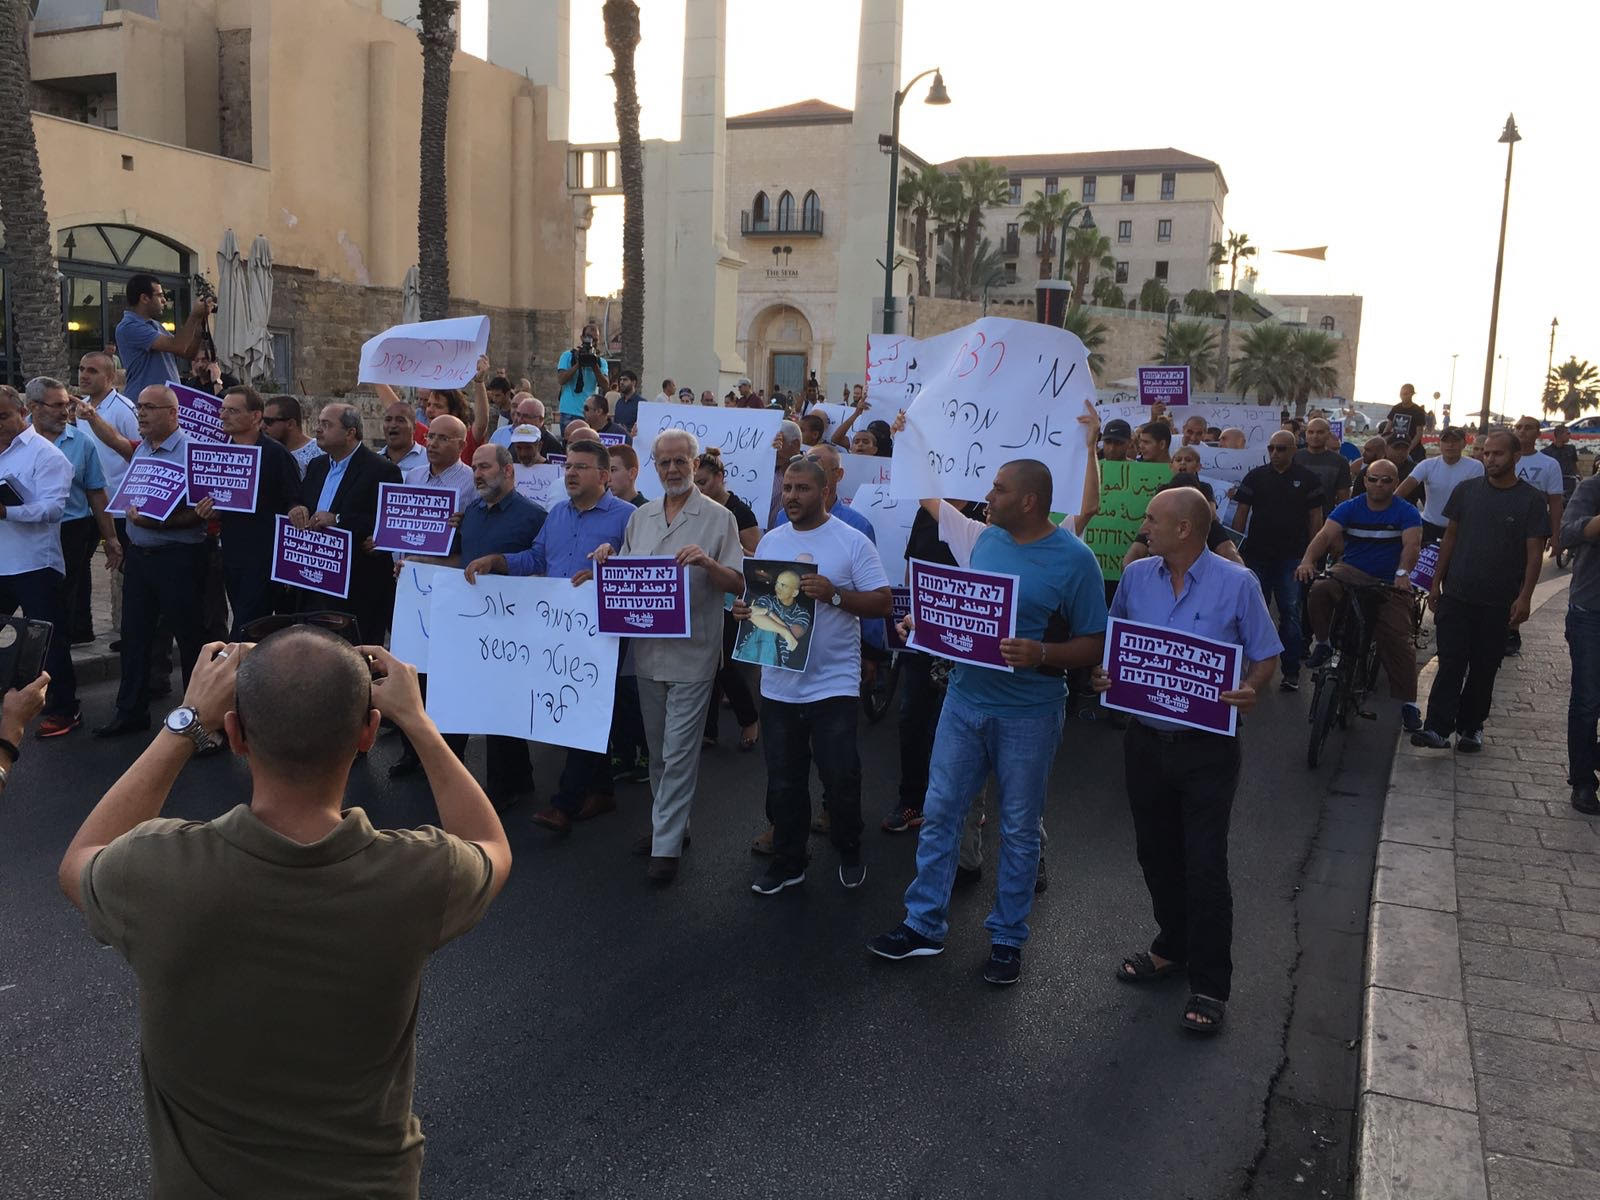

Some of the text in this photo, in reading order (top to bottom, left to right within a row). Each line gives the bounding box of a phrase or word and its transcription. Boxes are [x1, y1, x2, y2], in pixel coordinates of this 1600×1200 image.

[1038, 354, 1076, 398] מי
[942, 399, 999, 435] מהדי
[1000, 415, 1062, 449] את
[194, 451, 250, 465] לא לאלימות
[964, 441, 986, 477] אל
[169, 471, 185, 483] לא
[194, 475, 248, 488] המשטרתית
[389, 493, 447, 507] לא לאלימות
[286, 527, 343, 548] לא לאלימות
[388, 518, 445, 532] המשטרתית
[285, 551, 339, 571] המשטרתית
[604, 566, 673, 579] לא לאלימות
[920, 575, 1001, 600] לא לאלימות
[458, 592, 515, 618] את
[607, 597, 673, 608] המשטרתית
[922, 607, 996, 635] המשטרתית
[479, 635, 599, 688] השוטר הפושע
[1124, 635, 1222, 668] לא לאלימות
[1122, 669, 1216, 700] המשטרתית
[530, 684, 579, 735] לדין
